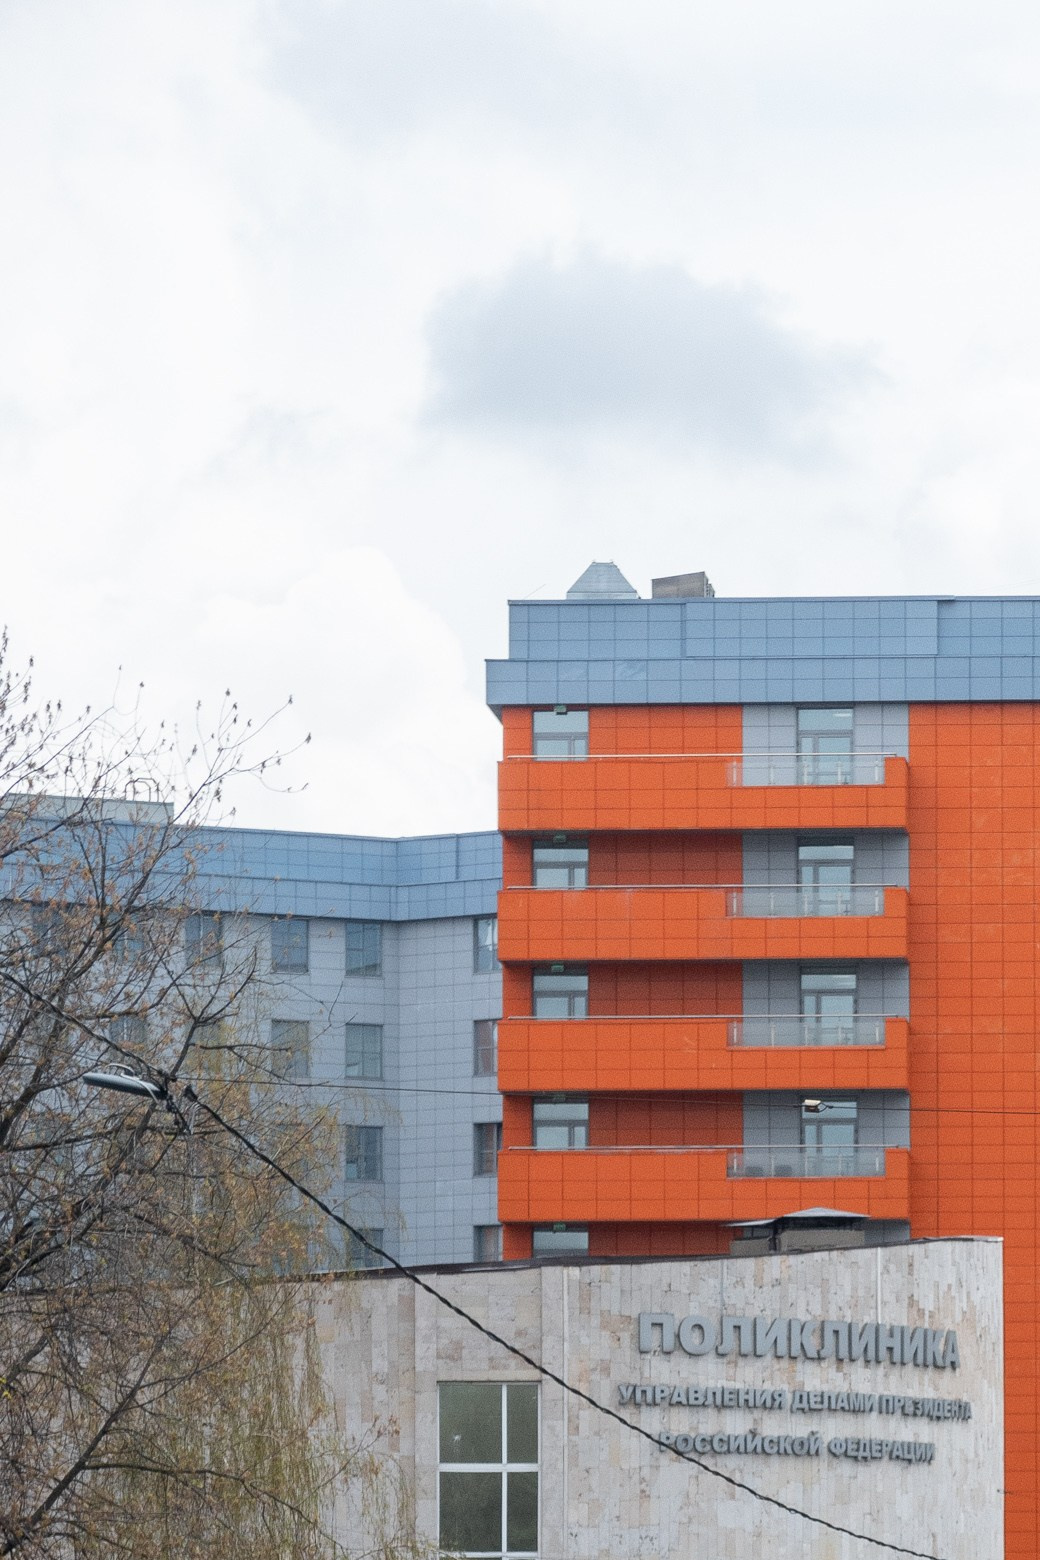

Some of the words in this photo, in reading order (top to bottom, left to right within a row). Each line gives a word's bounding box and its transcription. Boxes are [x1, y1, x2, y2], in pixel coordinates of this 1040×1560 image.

[638, 1312, 961, 1371] ПОЛИКЛИНИКА
[618, 1384, 788, 1410] УПРАВЛЕНИЯ
[790, 1390, 876, 1414] ДЕЛАМИ
[878, 1394, 972, 1421] ПРЕЗИДЕНТА
[659, 1428, 823, 1457] РОССИЙСКОЙ
[827, 1436, 935, 1464] ФЕДЕРАЦИИ
